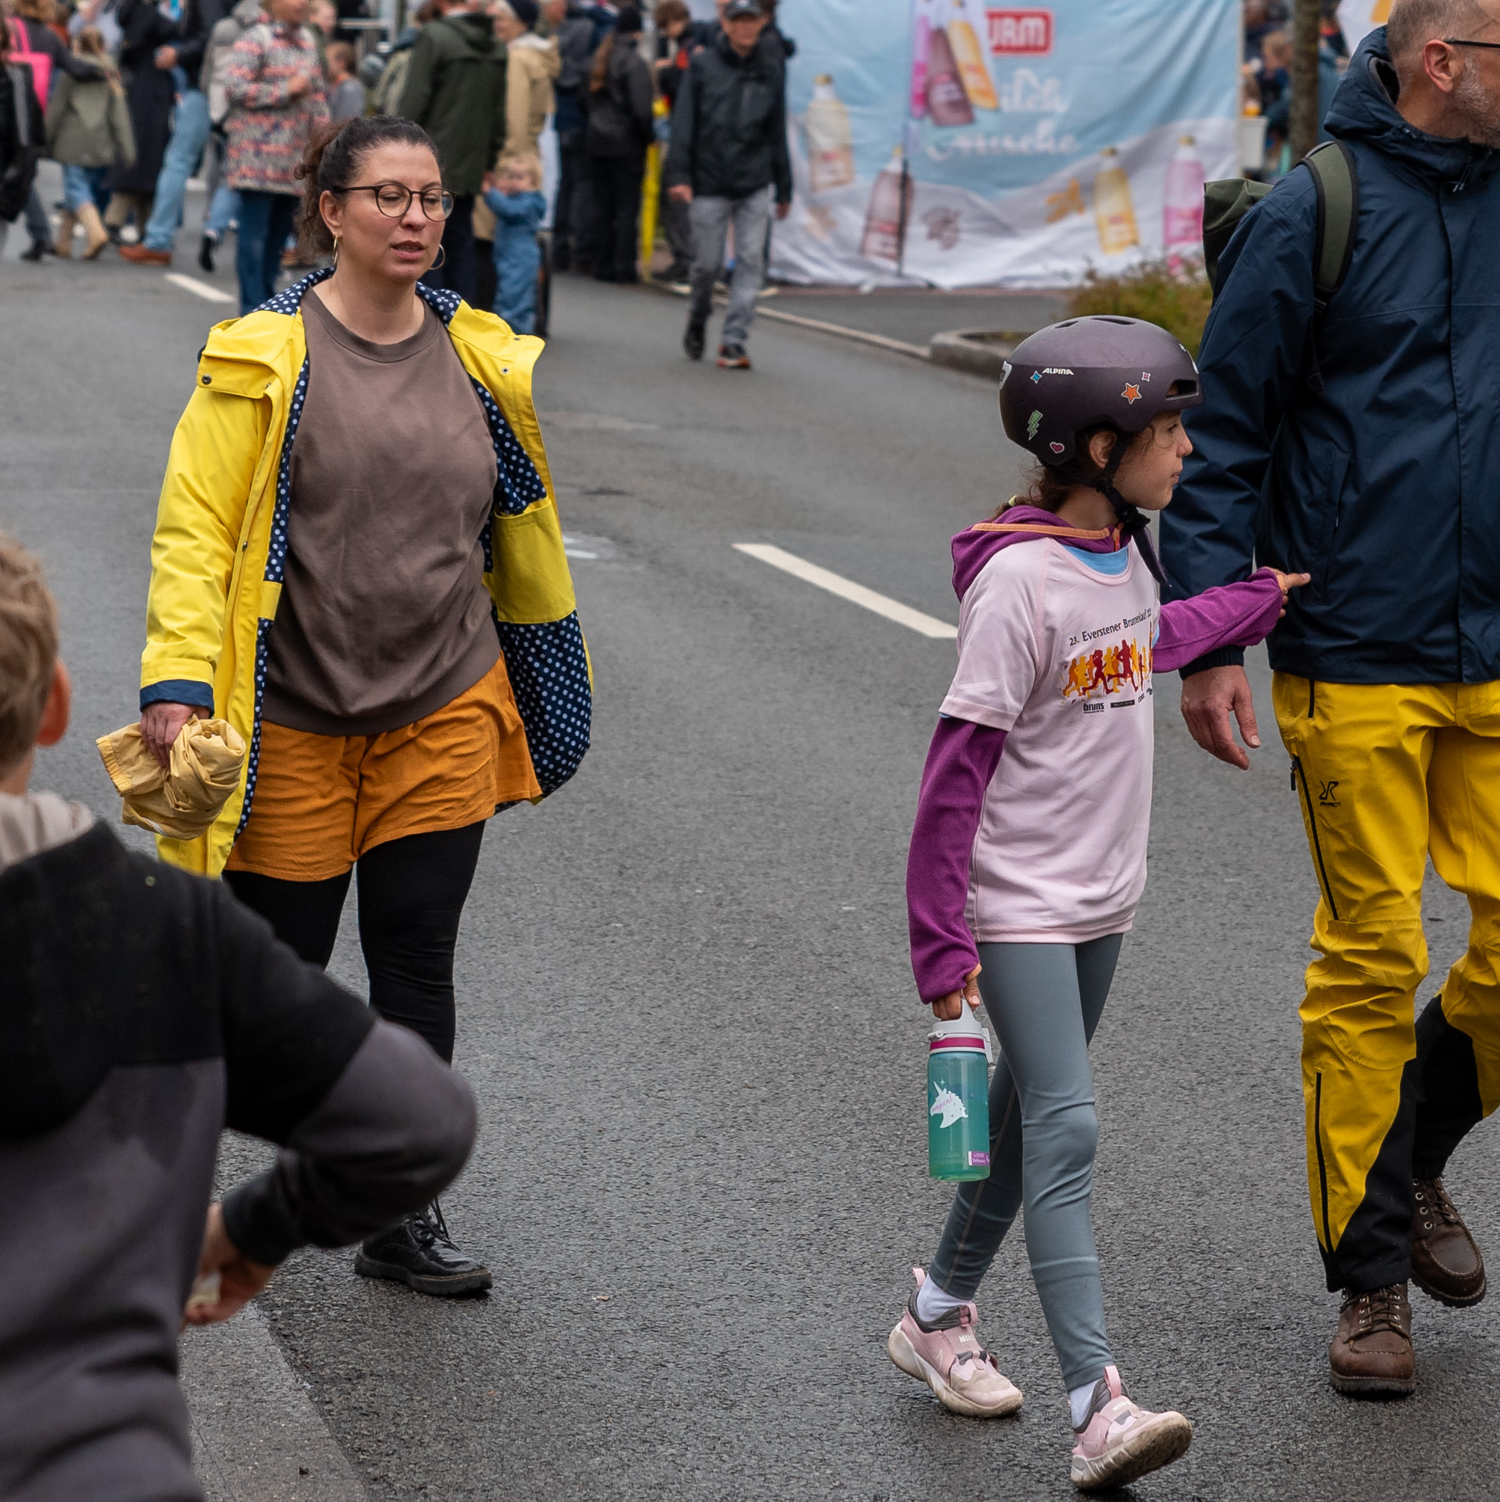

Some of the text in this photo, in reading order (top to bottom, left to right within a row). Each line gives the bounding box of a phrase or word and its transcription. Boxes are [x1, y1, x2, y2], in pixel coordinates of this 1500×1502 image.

[988, 16, 1047, 48] URM
[1041, 367, 1075, 376] ALPINA
[1068, 636, 1080, 647] 23.
[1081, 621, 1122, 643] Everstener
[1083, 702, 1105, 712] bruns
